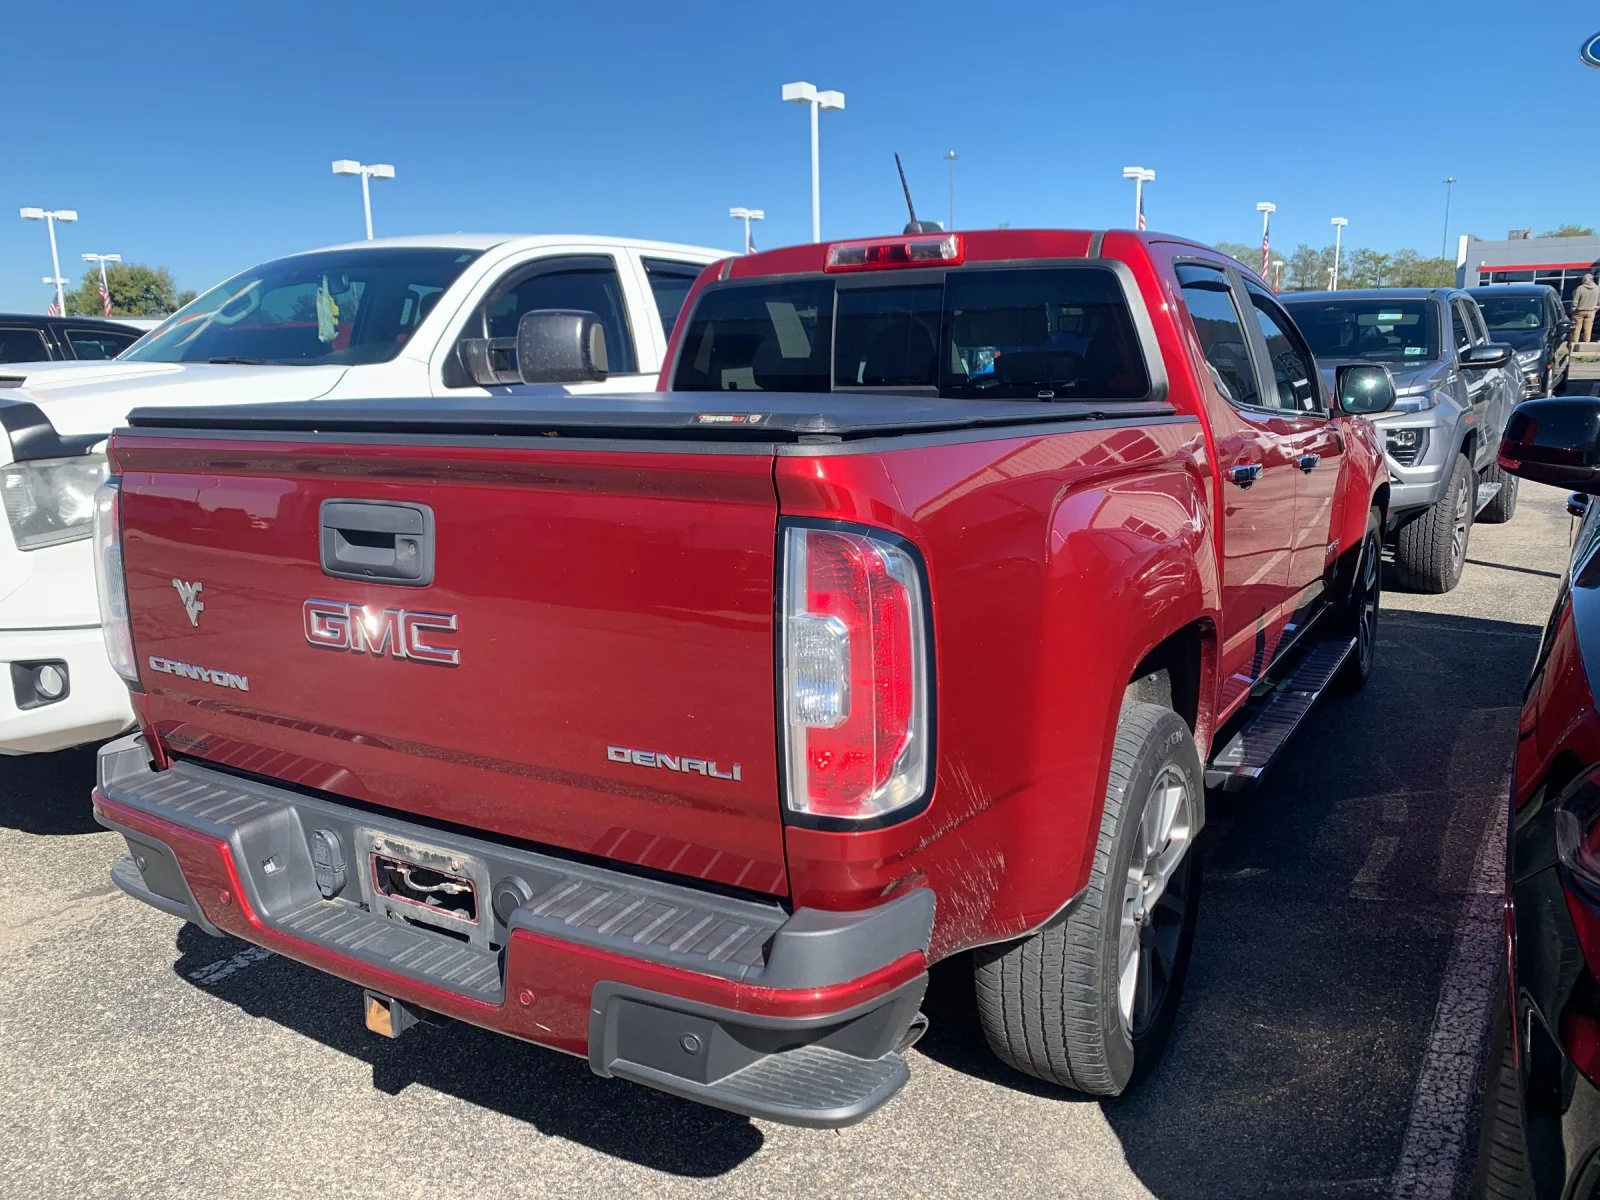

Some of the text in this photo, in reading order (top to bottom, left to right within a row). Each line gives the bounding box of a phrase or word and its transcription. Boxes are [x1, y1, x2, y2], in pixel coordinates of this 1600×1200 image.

[303, 598, 460, 665] GMC
[149, 655, 249, 691] CANYON
[607, 745, 742, 781] DENALI
